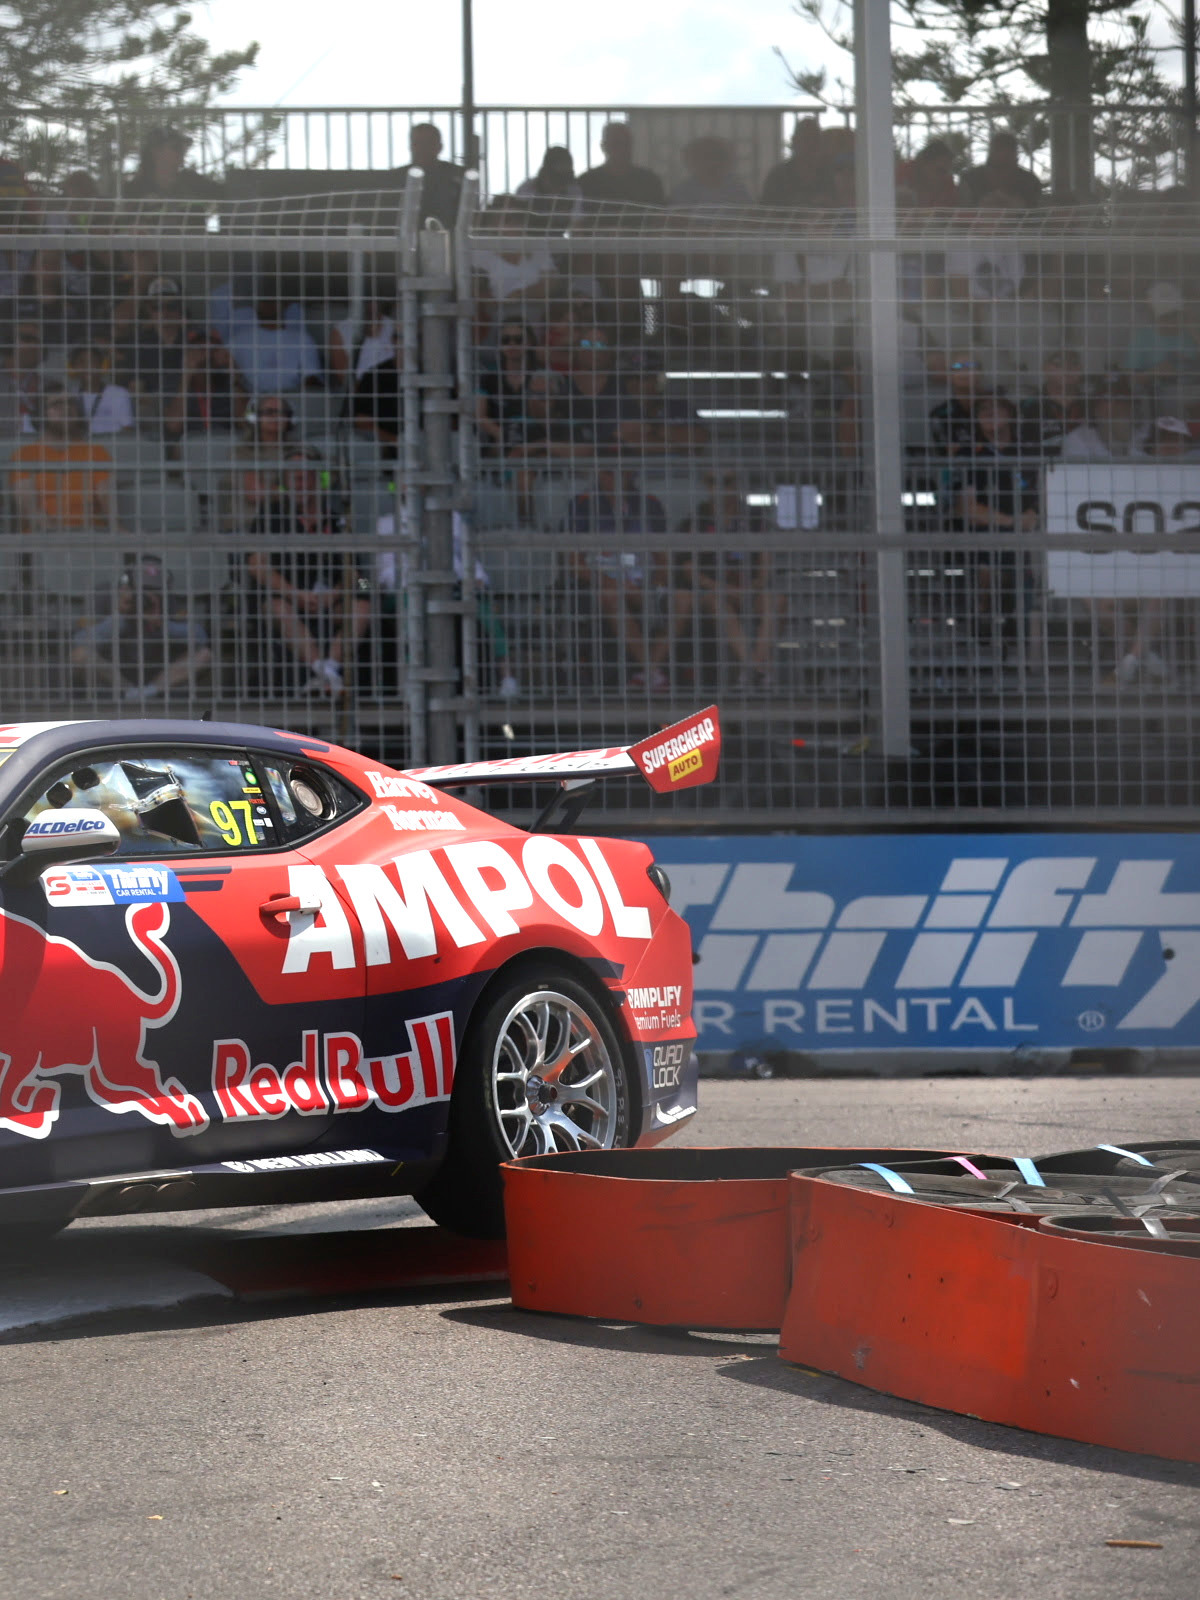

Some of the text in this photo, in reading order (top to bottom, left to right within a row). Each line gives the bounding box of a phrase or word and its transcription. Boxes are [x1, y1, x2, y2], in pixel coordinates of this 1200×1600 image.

[642, 717, 715, 774] SUPERCHEAP
[672, 754, 699, 777] AUTO
[364, 771, 439, 804] Harvey
[27, 818, 106, 834] ACDelco
[209, 800, 259, 846] 97
[379, 805, 467, 831] Norman
[103, 867, 169, 896] Thrifty
[116, 889, 131, 897] CAR
[131, 888, 157, 896] RENTAL
[281, 835, 652, 974] AMPOL
[634, 985, 682, 1009] AMPLIFY
[633, 1011, 659, 1031] emium
[661, 1009, 682, 1029] Fuels
[763, 997, 1039, 1034] RENTAL
[653, 1045, 684, 1067] QUAD
[653, 1066, 680, 1089] LOCK
[291, 1149, 386, 1167] HOLLAND
